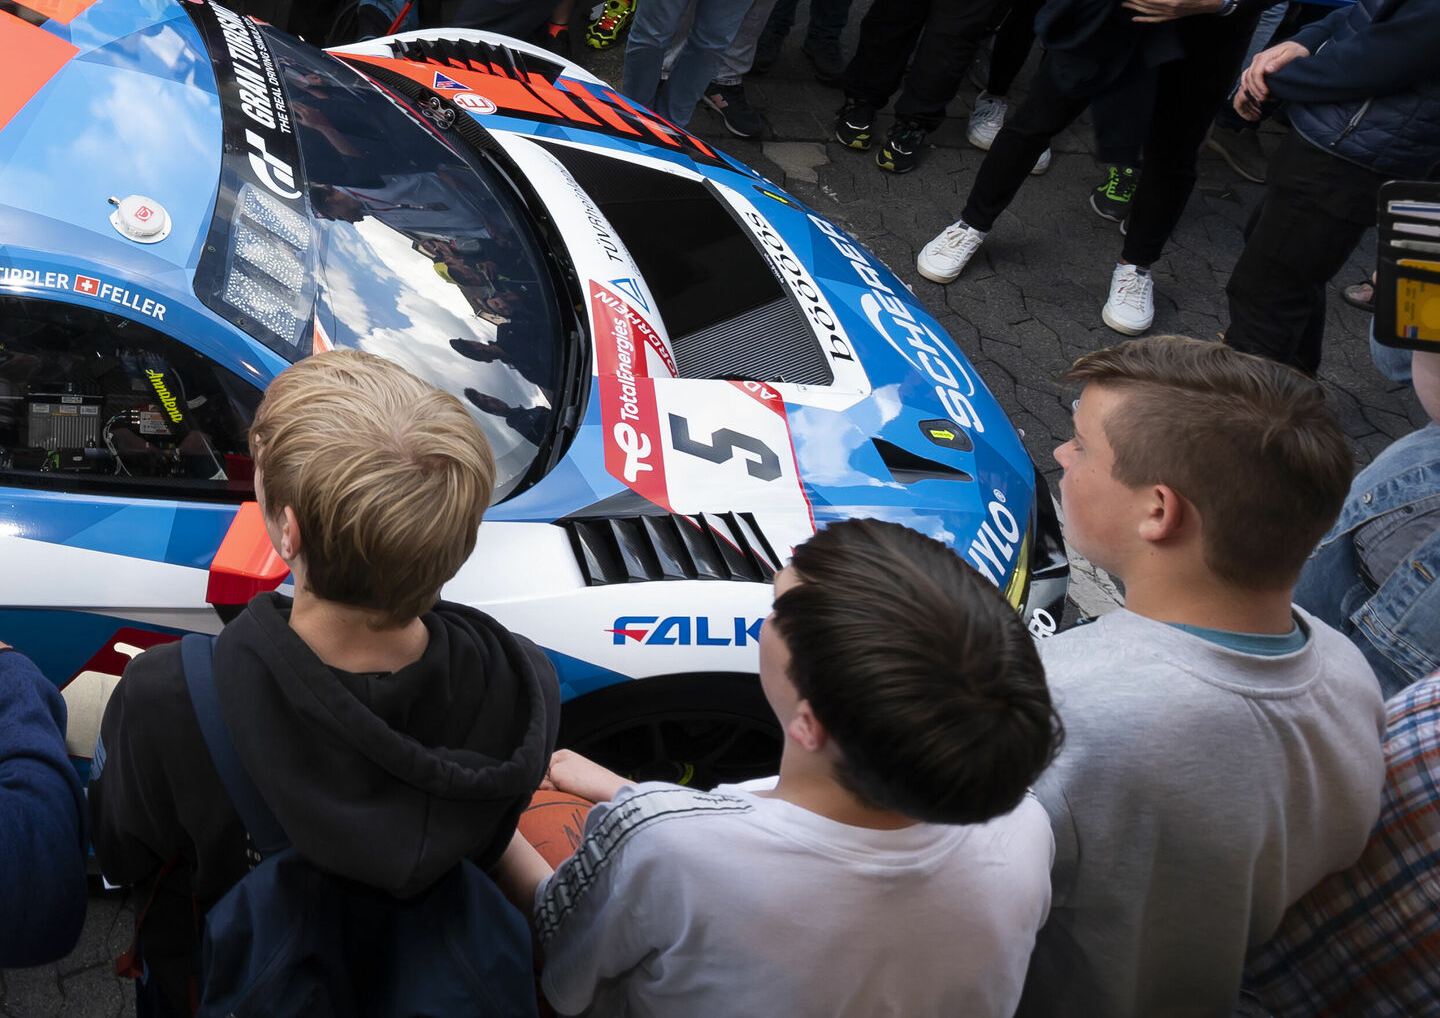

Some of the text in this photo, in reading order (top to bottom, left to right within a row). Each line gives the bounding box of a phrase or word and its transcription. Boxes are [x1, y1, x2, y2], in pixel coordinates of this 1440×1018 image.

[240, 70, 276, 130] GRAN
[262, 59, 282, 93] DRIVING
[274, 92, 288, 117] REAL
[279, 117, 292, 134] THE
[99, 283, 167, 322] FELLER
[806, 213, 984, 433] SCHERER
[594, 289, 679, 380] ORDRHEIN
[615, 316, 640, 423] TotalEnergies
[668, 412, 783, 483] 5
[612, 615, 762, 647] FALK
